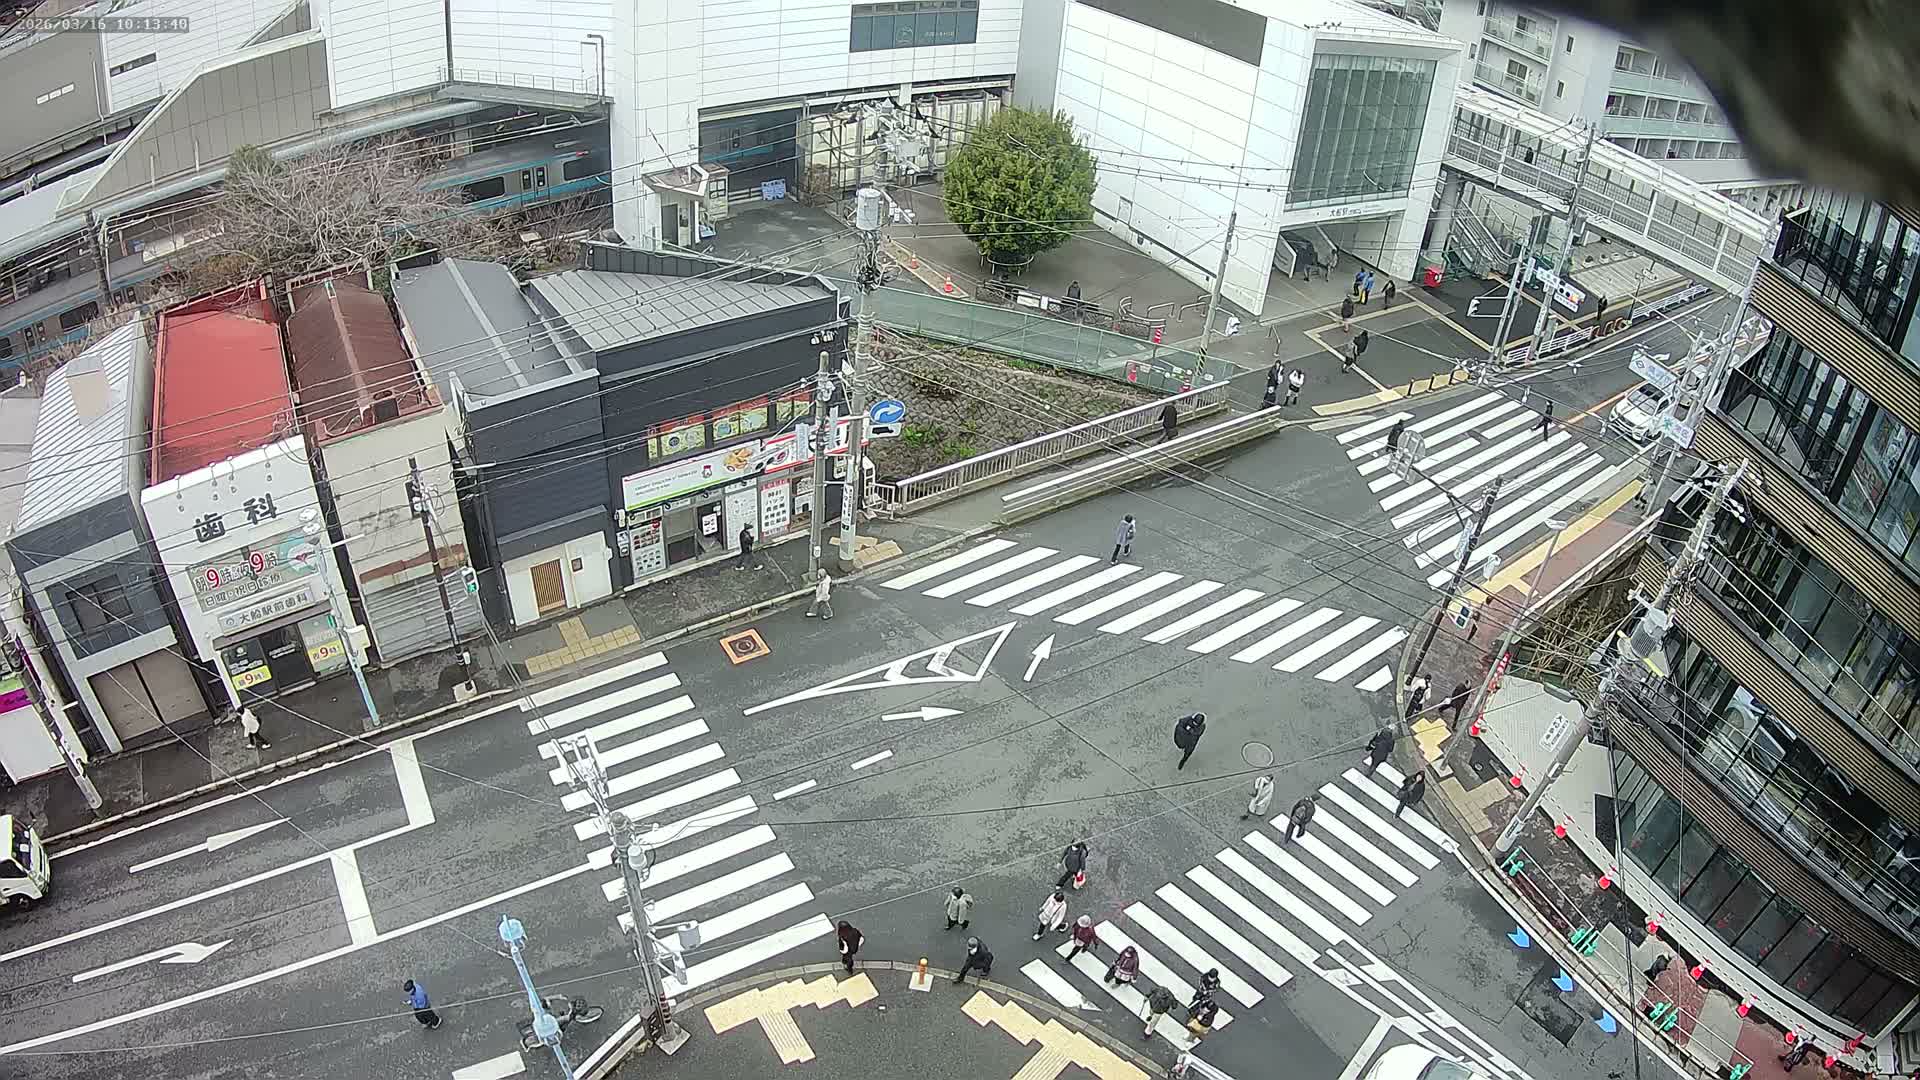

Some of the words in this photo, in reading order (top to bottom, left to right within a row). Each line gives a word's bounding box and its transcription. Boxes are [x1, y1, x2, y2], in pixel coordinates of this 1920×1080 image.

[193, 493, 277, 543] 歯科
[239, 592, 308, 625] 大船駅前歯科
